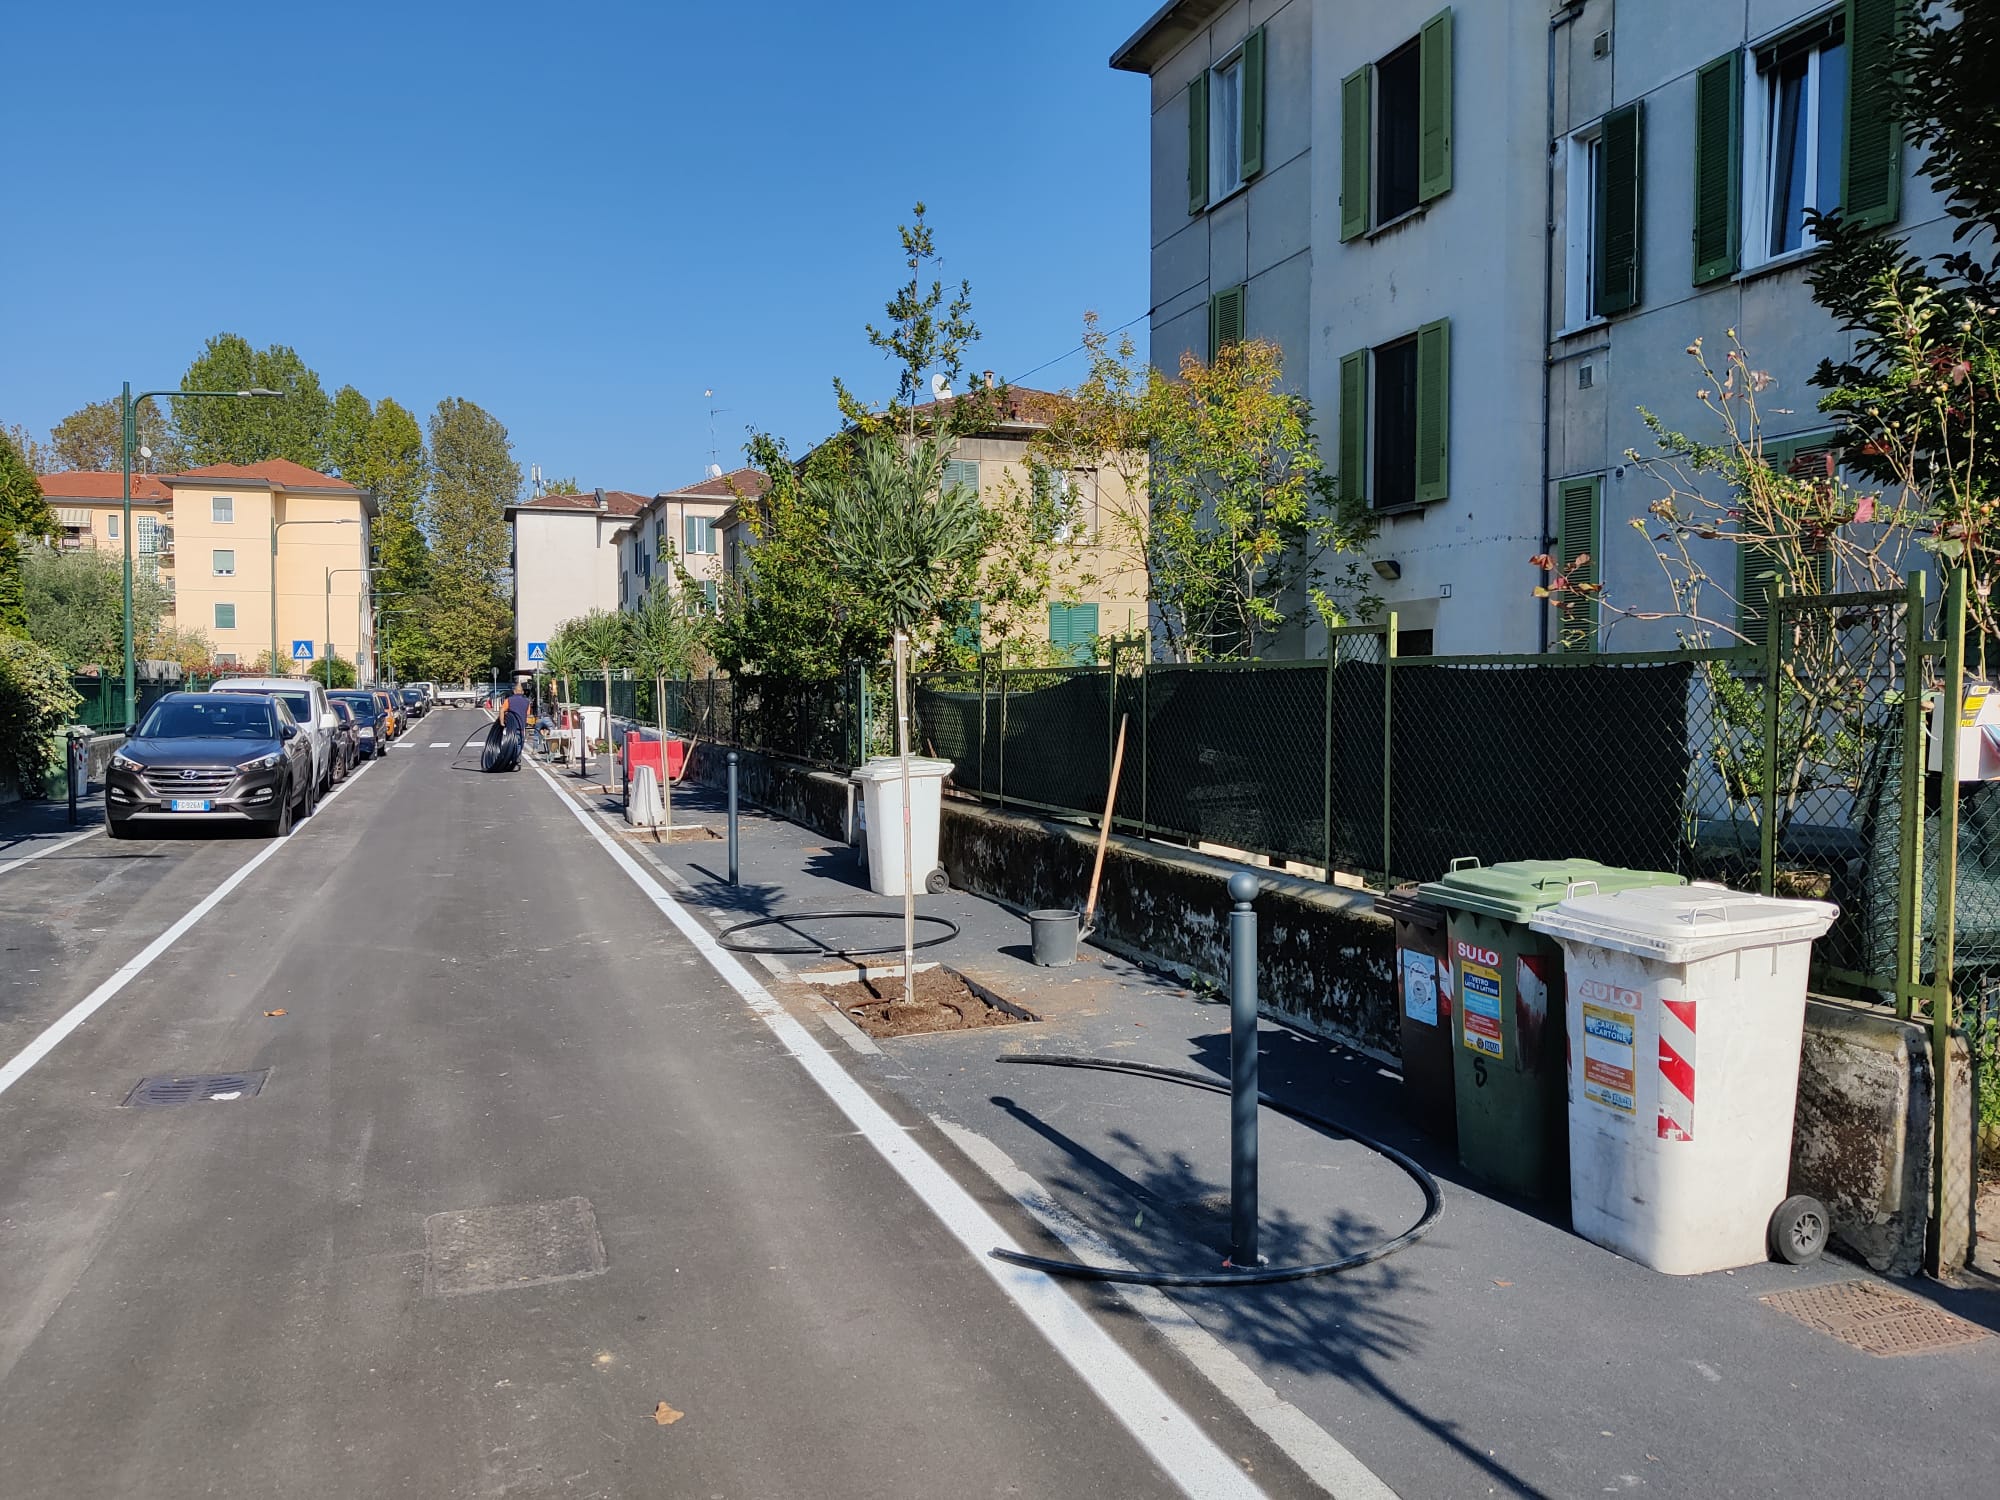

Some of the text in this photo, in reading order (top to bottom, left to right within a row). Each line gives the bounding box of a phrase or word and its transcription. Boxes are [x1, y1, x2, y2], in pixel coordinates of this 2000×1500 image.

[1458, 942, 1499, 966] SULO
[1470, 975, 1489, 986] VETRO
[1581, 981, 1637, 1008] SULO
[1597, 1018, 1618, 1031] CARTA
[1595, 1027, 1627, 1042] CARTONE
